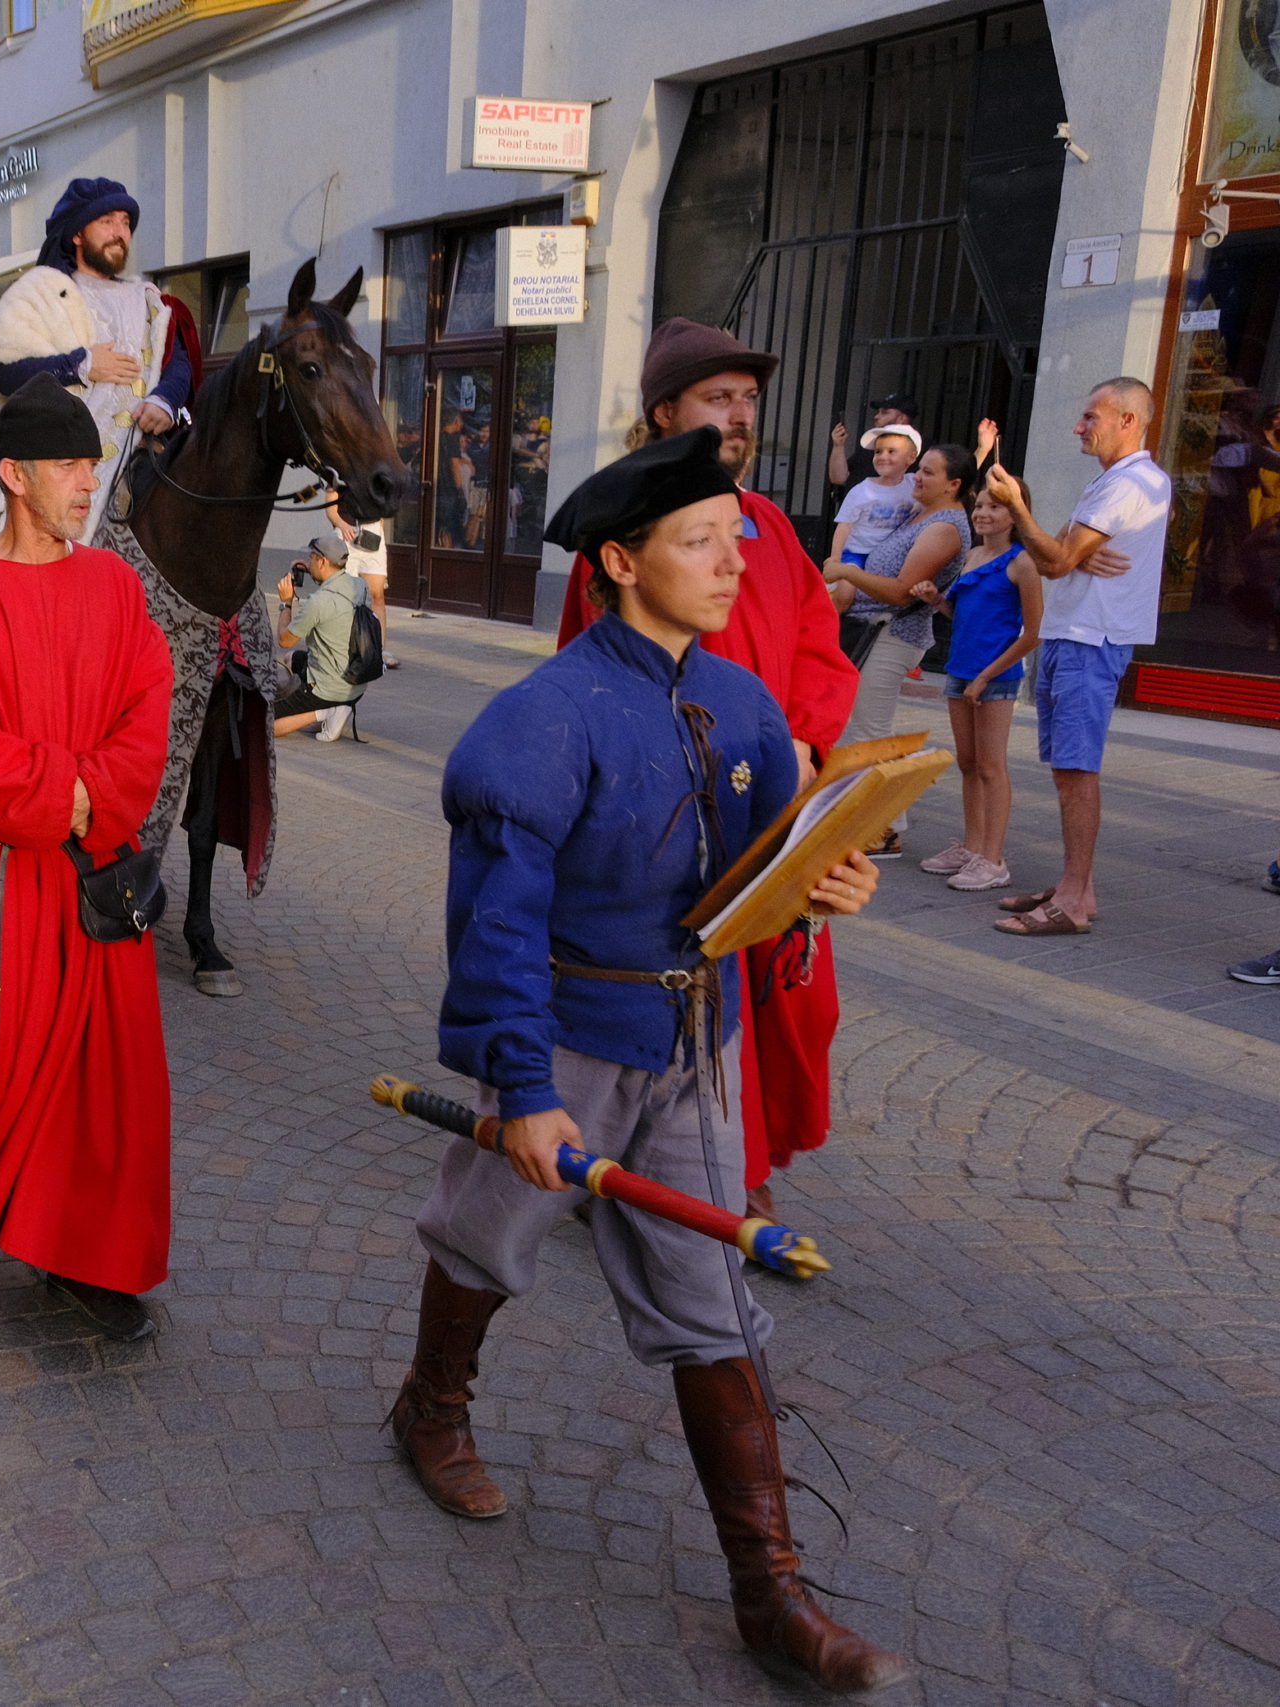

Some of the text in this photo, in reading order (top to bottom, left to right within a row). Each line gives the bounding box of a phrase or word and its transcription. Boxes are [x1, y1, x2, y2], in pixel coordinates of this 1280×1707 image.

[480, 103, 586, 125] SAPIENT
[478, 126, 530, 137] Imobiliare
[497, 138, 558, 152] Real Estate
[477, 154, 584, 166] www.sapientimobiliare.com
[1082, 253, 1094, 286] 1
[512, 275, 580, 286] BIROU NOTARIAL
[521, 285, 572, 296] Notari publici
[512, 296, 580, 306] DEHELEAN CORNEL
[515, 306, 576, 317] DEHELEAN SILVIU
